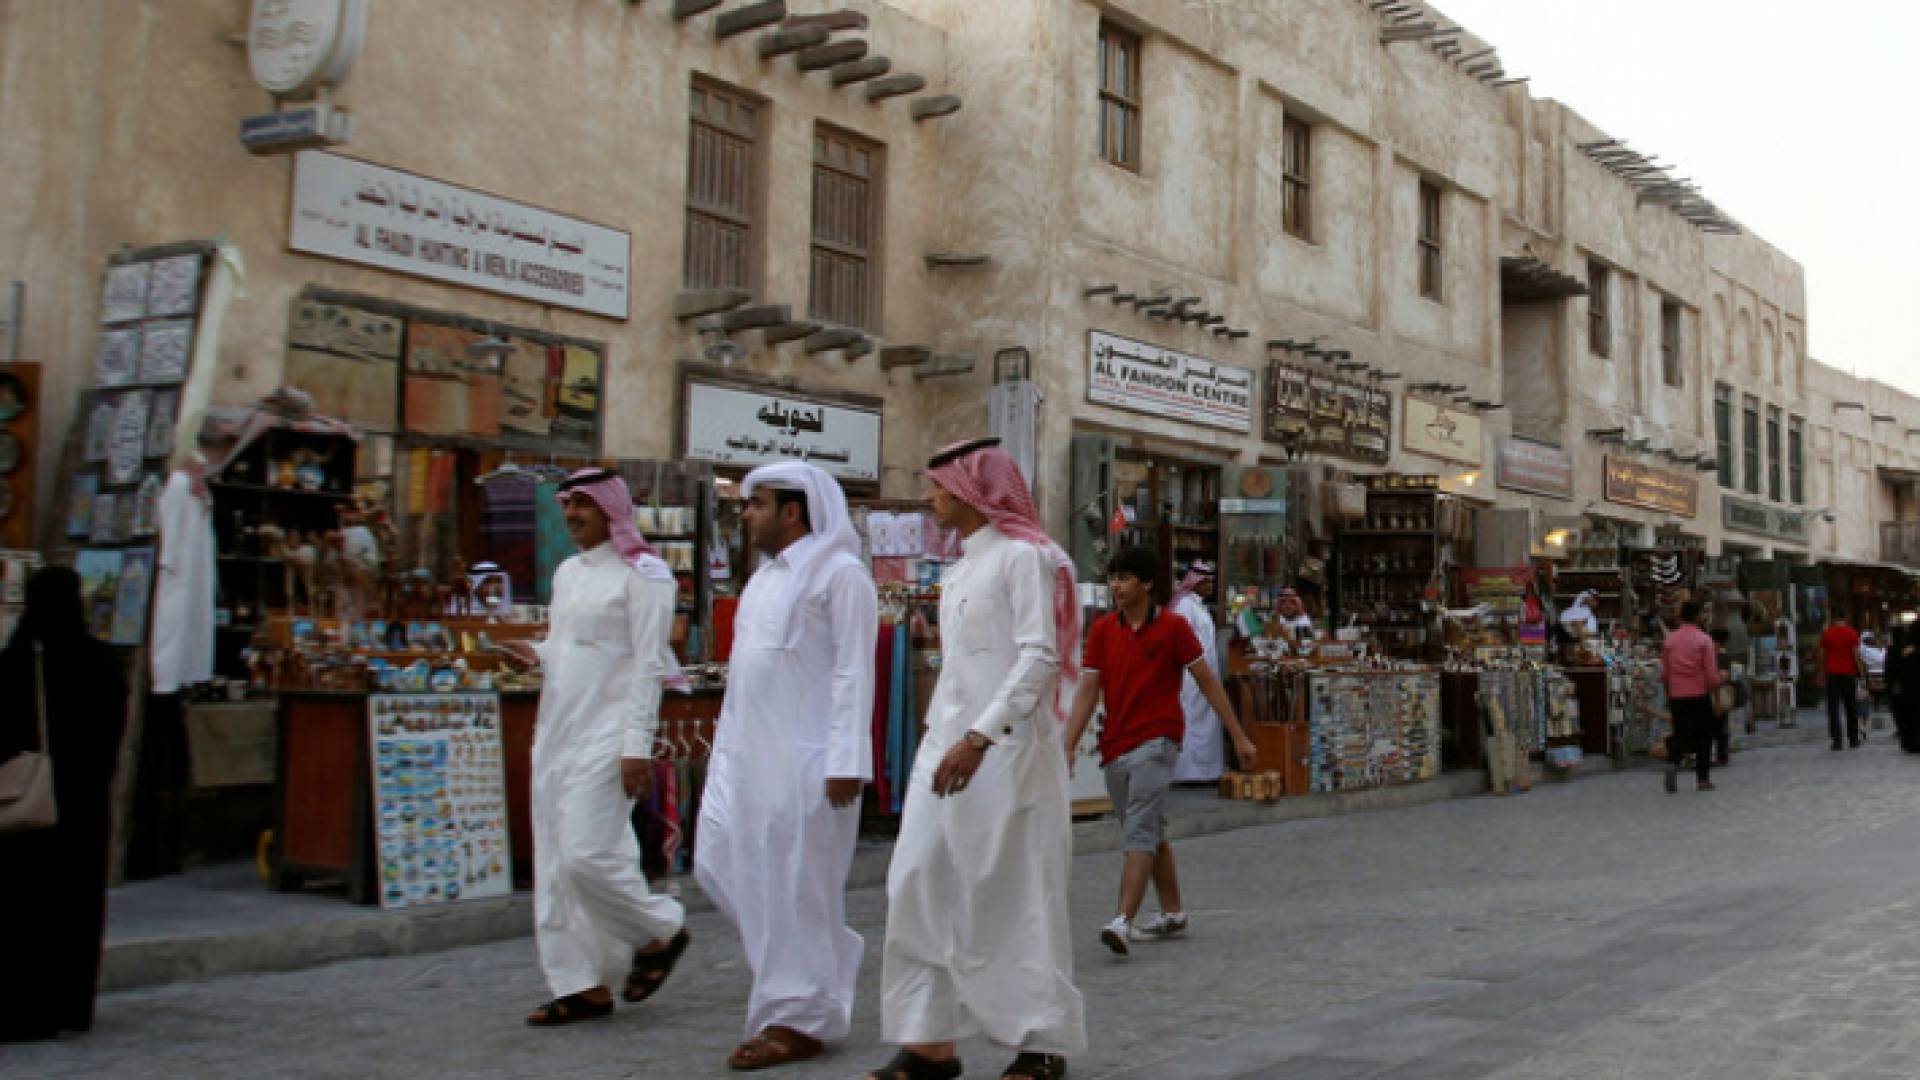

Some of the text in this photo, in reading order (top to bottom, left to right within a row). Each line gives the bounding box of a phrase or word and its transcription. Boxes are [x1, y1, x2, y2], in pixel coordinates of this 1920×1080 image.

[355, 223, 371, 249] AL
[418, 238, 469, 271] HUNTING
[519, 261, 585, 297] ACCESSORIES
[1095, 360, 1115, 378] AL
[1120, 365, 1187, 394] FANOON
[1192, 382, 1249, 409] CENTRE
